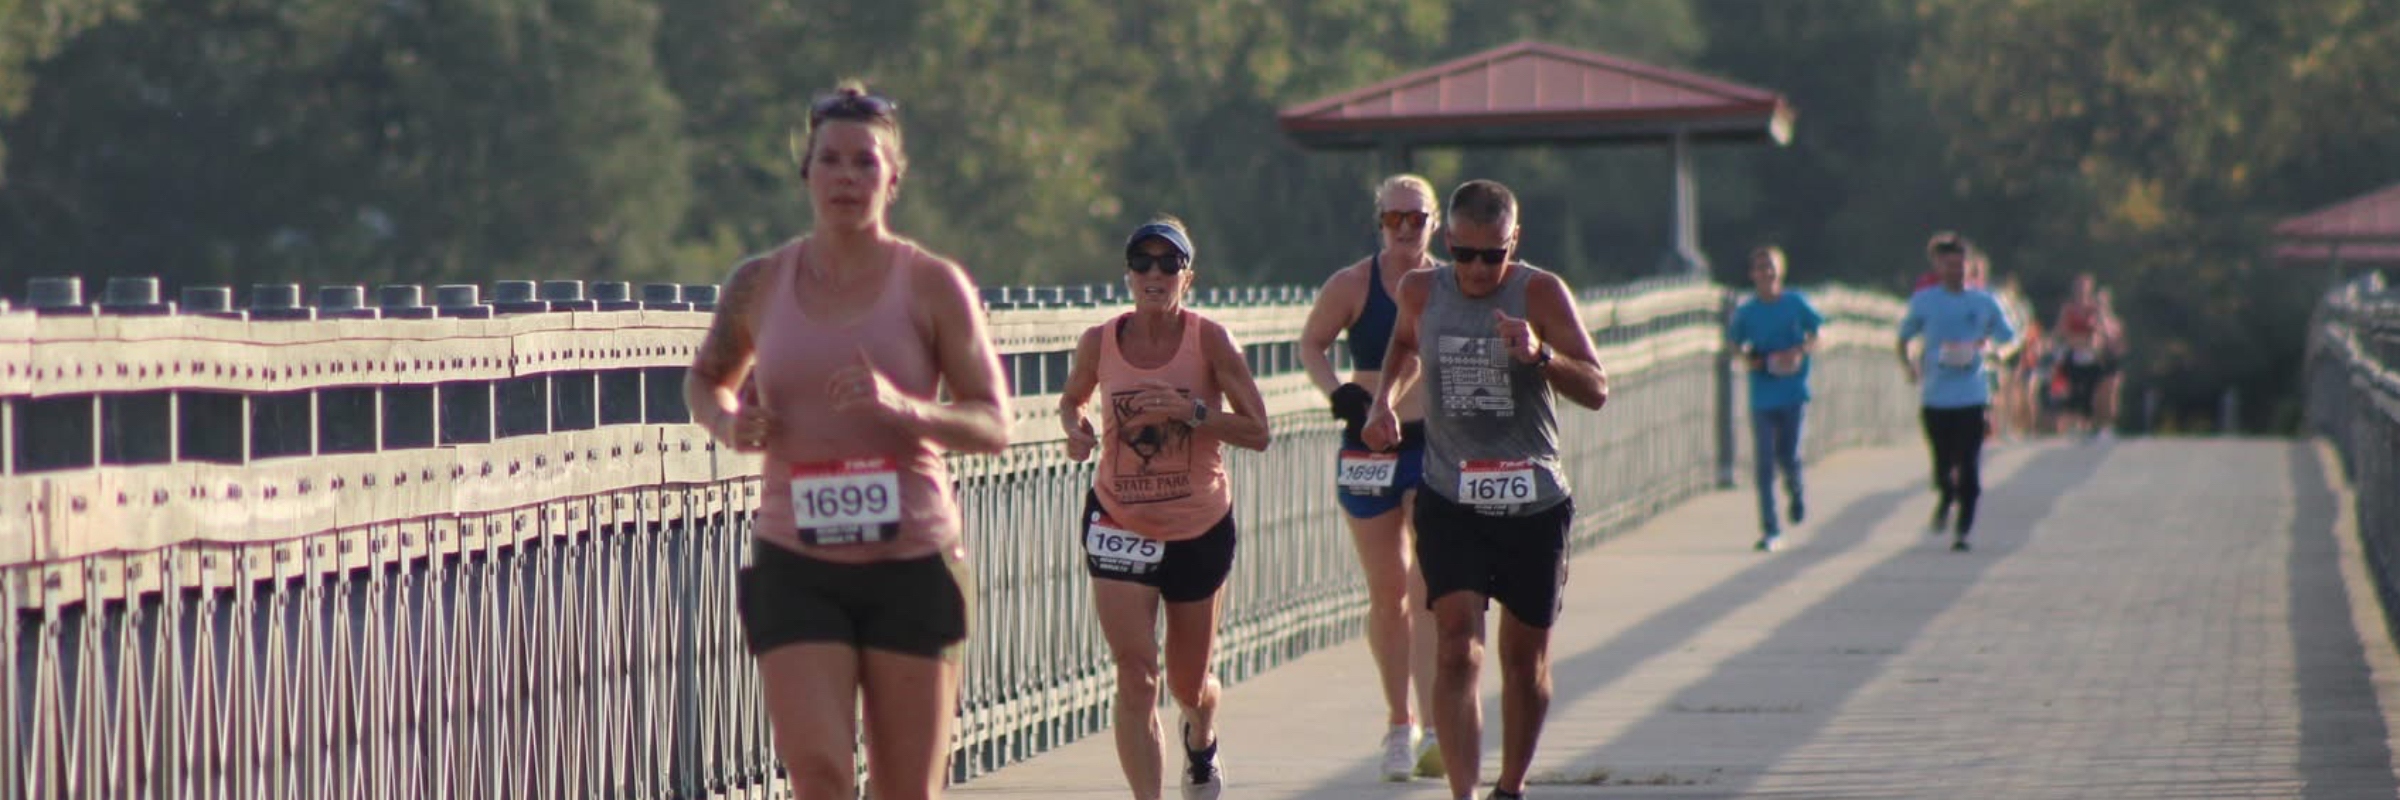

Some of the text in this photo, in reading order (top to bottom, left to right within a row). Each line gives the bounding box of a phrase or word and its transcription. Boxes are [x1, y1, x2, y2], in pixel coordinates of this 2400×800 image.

[1347, 464, 1389, 481] 1696
[1115, 478, 1154, 492] STATE
[1467, 476, 1528, 499] 1676
[802, 484, 888, 518] 1699
[1096, 533, 1156, 557] 1675
